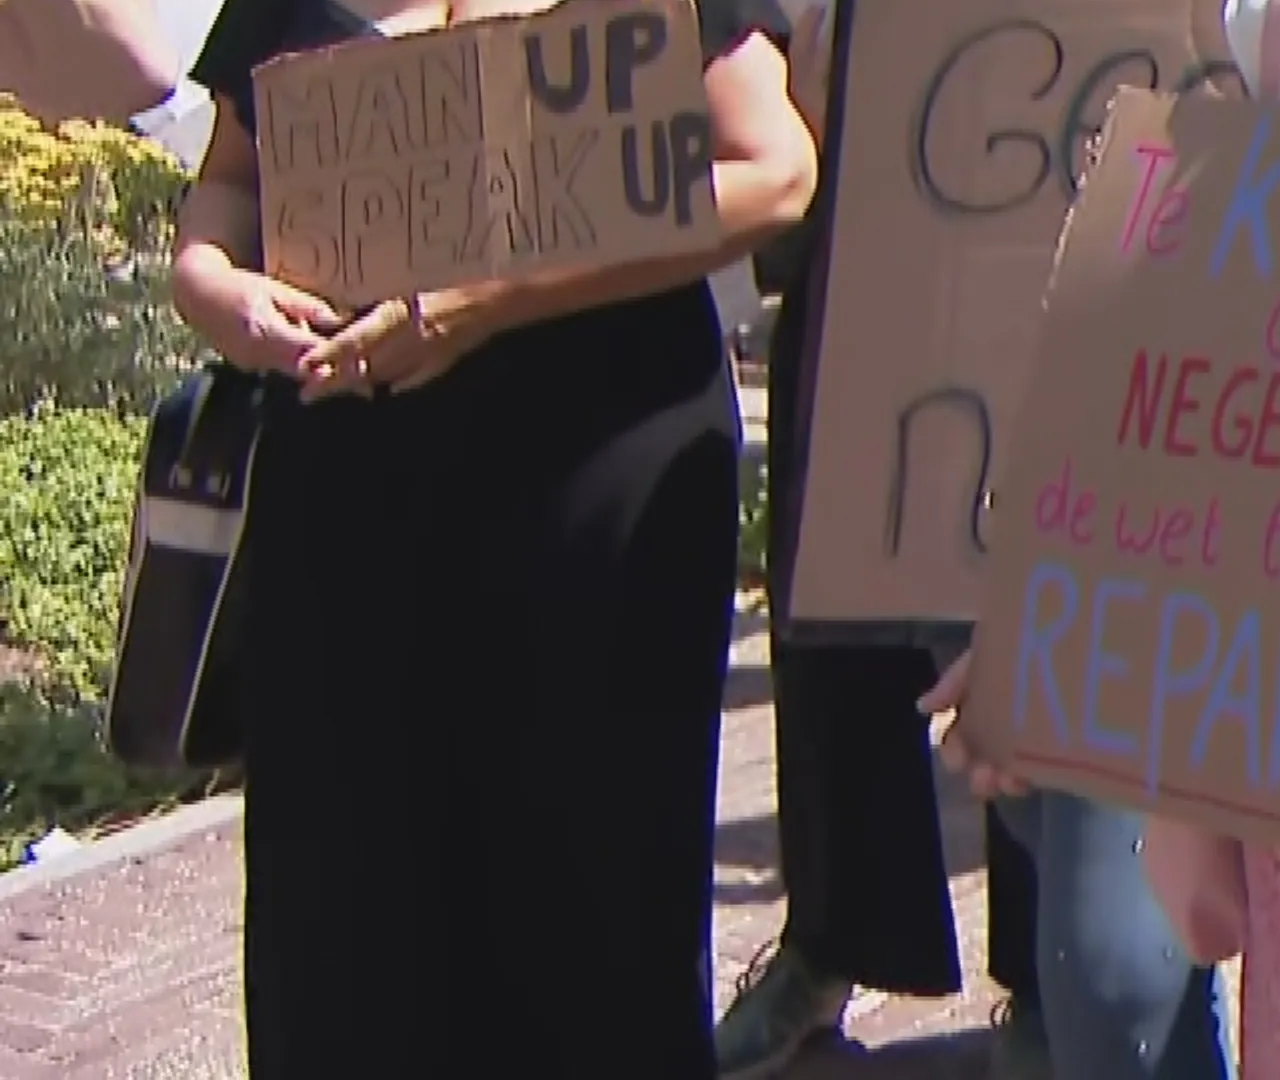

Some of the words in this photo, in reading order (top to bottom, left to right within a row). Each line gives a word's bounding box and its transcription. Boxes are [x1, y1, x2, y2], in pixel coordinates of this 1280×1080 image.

[262, 39, 485, 179] MAN
[524, 14, 669, 114] UP
[272, 129, 603, 292] SPEAK
[620, 111, 706, 226] UP
[1120, 147, 1192, 260] Te
[1035, 457, 1095, 544] de
[1114, 494, 1219, 570] wet
